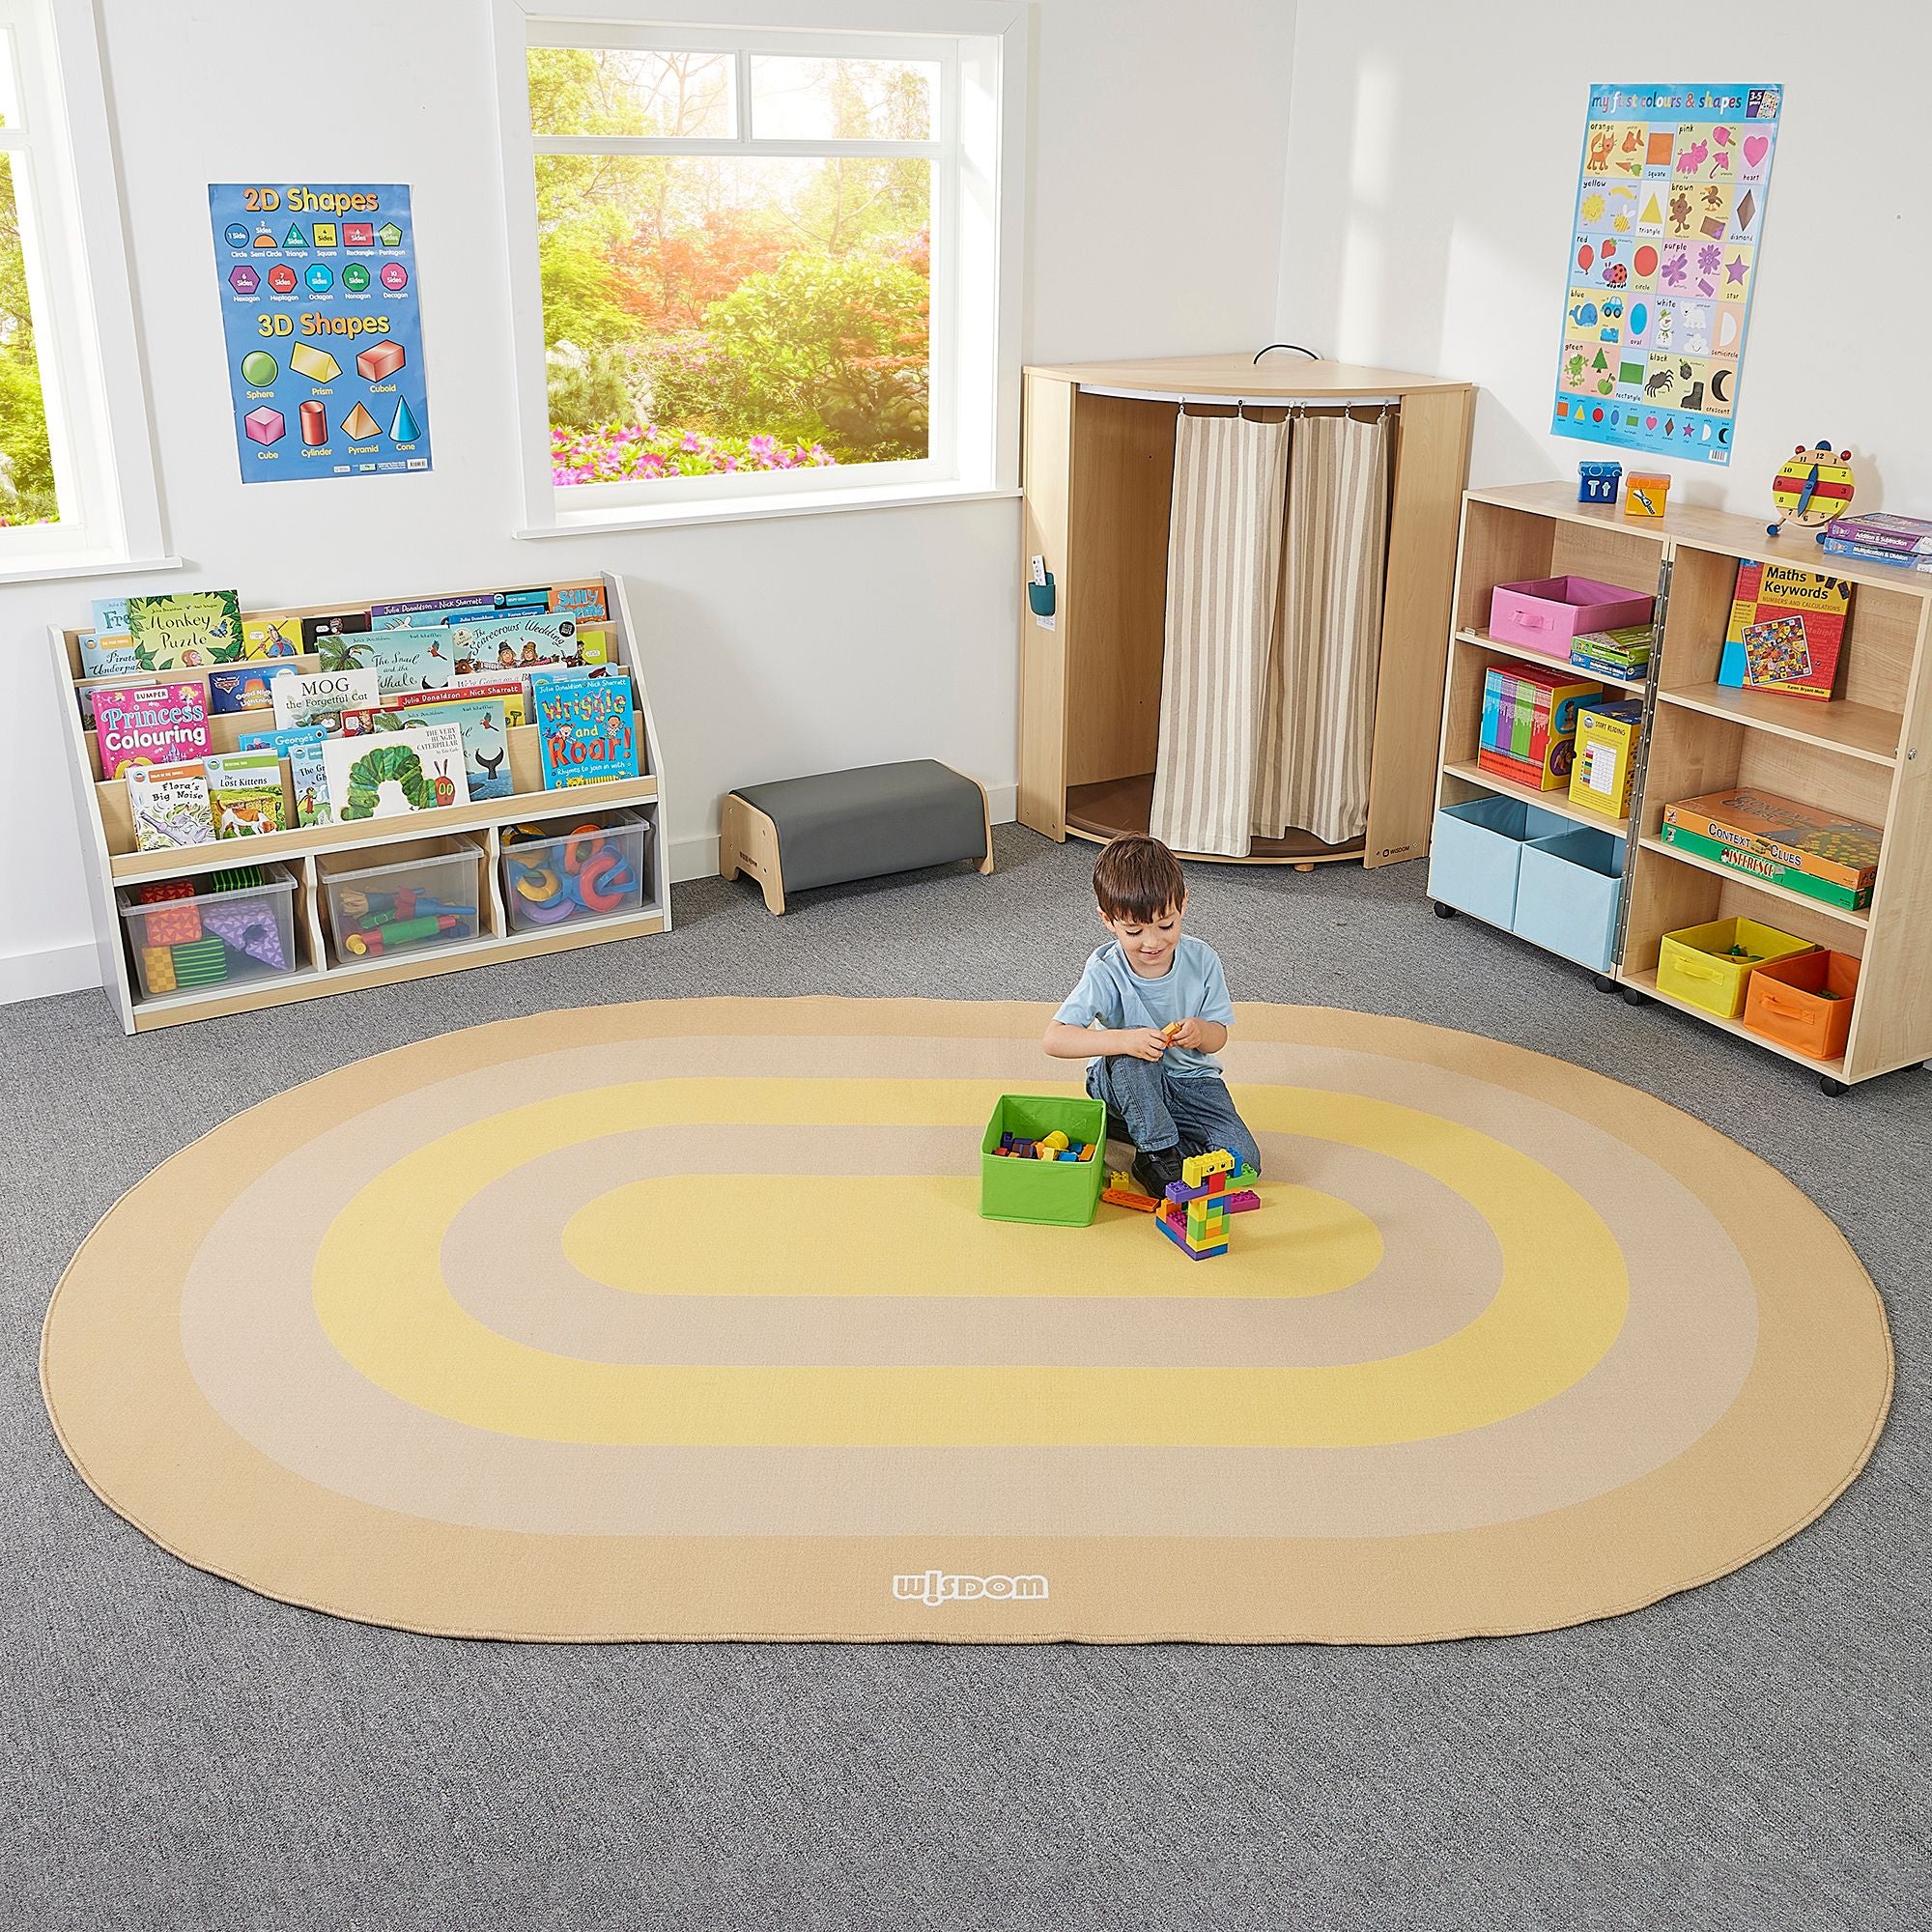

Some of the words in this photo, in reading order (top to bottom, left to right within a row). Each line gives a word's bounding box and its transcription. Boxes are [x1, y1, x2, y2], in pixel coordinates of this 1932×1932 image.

[1592, 95, 1609, 113] my
[1610, 92, 1637, 113] first
[1640, 94, 1681, 108] colours
[1686, 94, 1694, 107] &
[1698, 92, 1742, 114] shapes
[1679, 125, 1693, 134] pink
[1583, 180, 1605, 188] yellow
[243, 187, 280, 212] 2D
[288, 186, 379, 216] Shapes
[1664, 242, 1687, 251] purple
[258, 314, 294, 337] 3D
[300, 312, 390, 339] Shapes
[1650, 353, 1667, 361] black
[246, 390, 274, 399] Sphere
[312, 387, 333, 396] Prism
[370, 384, 396, 393] Cuboid
[301, 448, 332, 457] Cylinder
[348, 445, 379, 454] Pyramid
[396, 442, 415, 451] Cone
[258, 451, 278, 460] Cube
[1767, 566, 1807, 582] Maths
[1764, 581, 1829, 600] Keywords
[402, 604, 432, 612] Donaldson
[439, 600, 454, 609] Nick
[455, 598, 482, 607] Sharratt
[558, 589, 598, 607] Silly
[1763, 596, 1787, 606] NUMBERS
[1802, 601, 1840, 612] CALCULATIONS
[146, 612, 211, 631] Monkey
[469, 621, 522, 656] Scarecrows'
[525, 619, 565, 647] Wedding
[159, 632, 207, 649] Puzzle
[371, 652, 389, 668] The
[392, 651, 419, 665] Snail
[301, 677, 350, 696] MOG
[136, 691, 167, 700] BUMPER
[236, 691, 255, 699] Good
[286, 698, 301, 710] the
[305, 695, 349, 709] Forgetful
[352, 693, 368, 704] Cat
[542, 689, 627, 724] Wriggle
[101, 704, 204, 731] Princess
[105, 725, 207, 752] Colouring
[431, 734, 457, 743] HUNGRY
[576, 725, 599, 738] and
[275, 733, 313, 745] George's
[416, 740, 458, 751] CATERPILLAR
[547, 727, 632, 769] Roar!
[556, 766, 581, 777] Rhymes
[590, 764, 602, 774] join
[162, 781, 200, 791] Flora's
[220, 779, 237, 787] Lost
[239, 778, 268, 786] Kittens
[1708, 822, 1752, 848] CONTEXT
[1769, 843, 1803, 867] CLUES
[1728, 849, 1774, 878] INFERENCE
